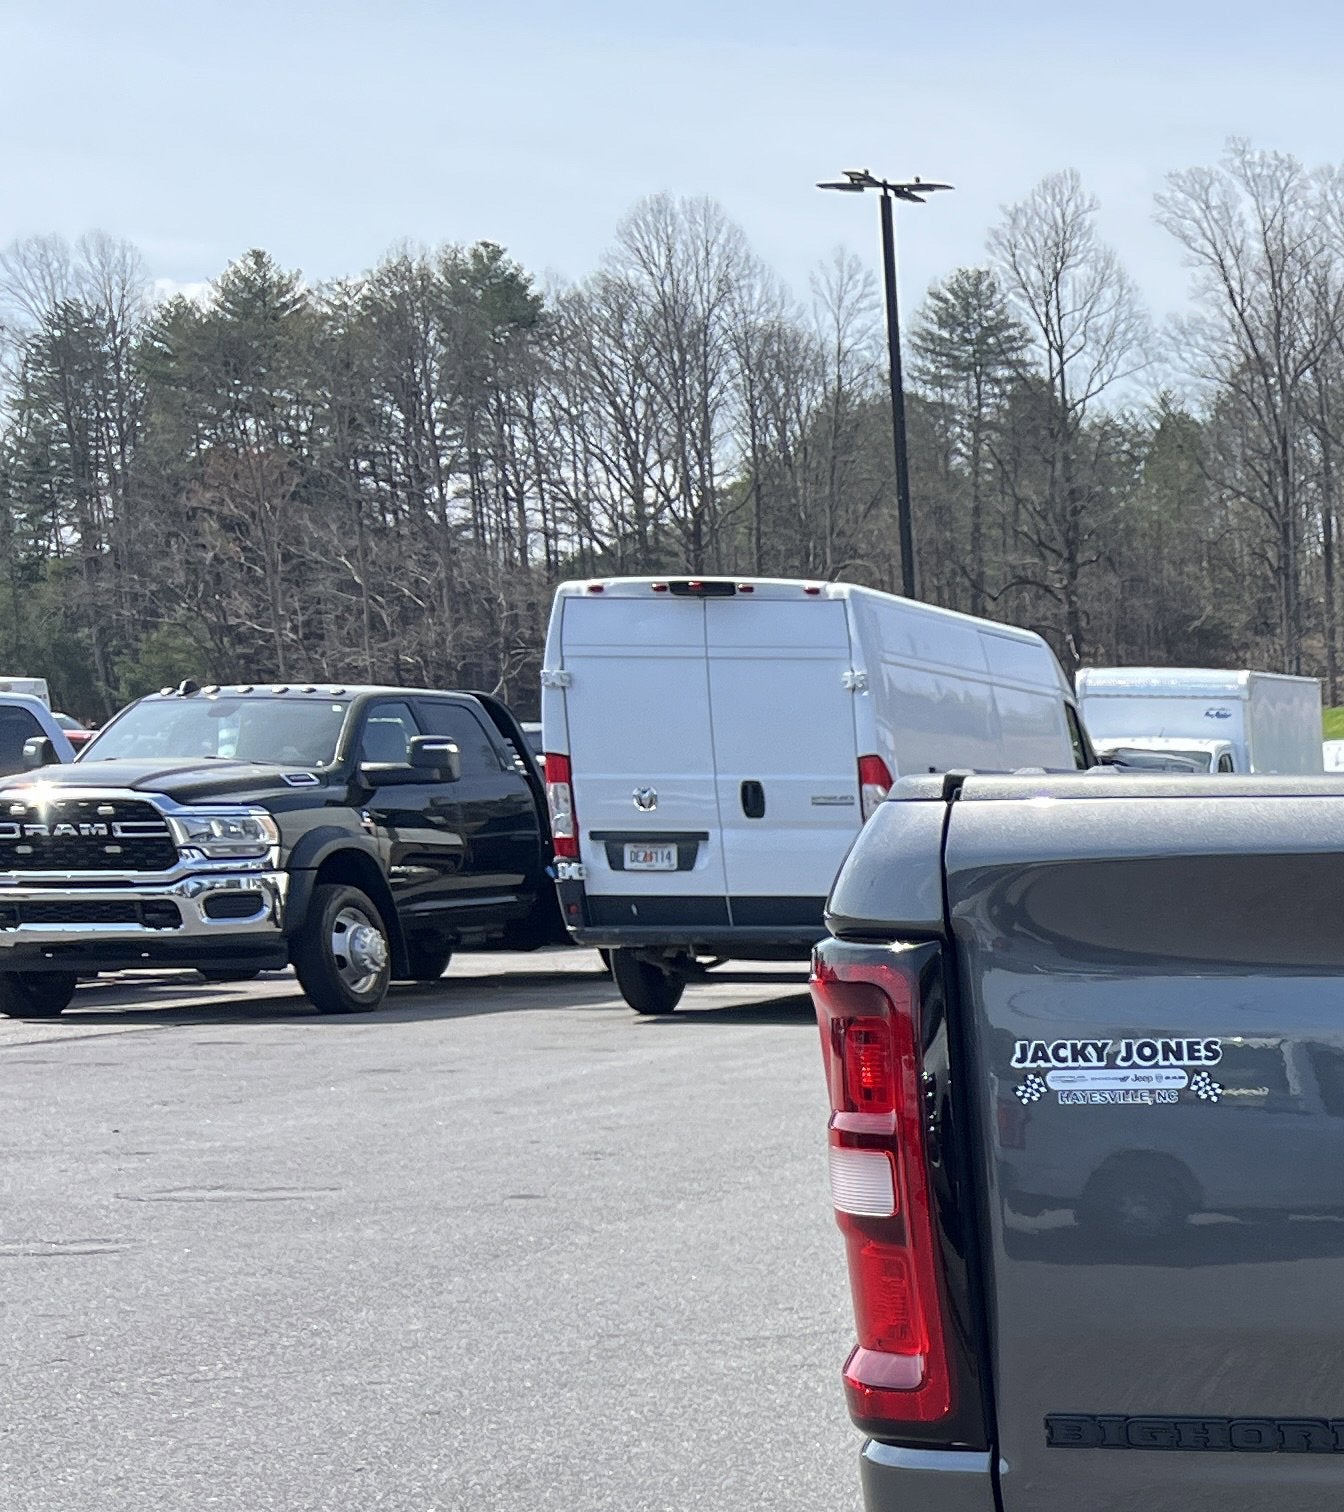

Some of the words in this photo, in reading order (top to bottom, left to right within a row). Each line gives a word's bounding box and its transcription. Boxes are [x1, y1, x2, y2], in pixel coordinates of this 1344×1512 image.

[23, 823, 109, 837] RAM
[1010, 1040, 1113, 1069] JACKY
[1116, 1038, 1223, 1067] JONES
[1131, 1074, 1154, 1084] Jeep
[1058, 1089, 1154, 1106] HAYESVILLE,
[1155, 1089, 1179, 1104] NC
